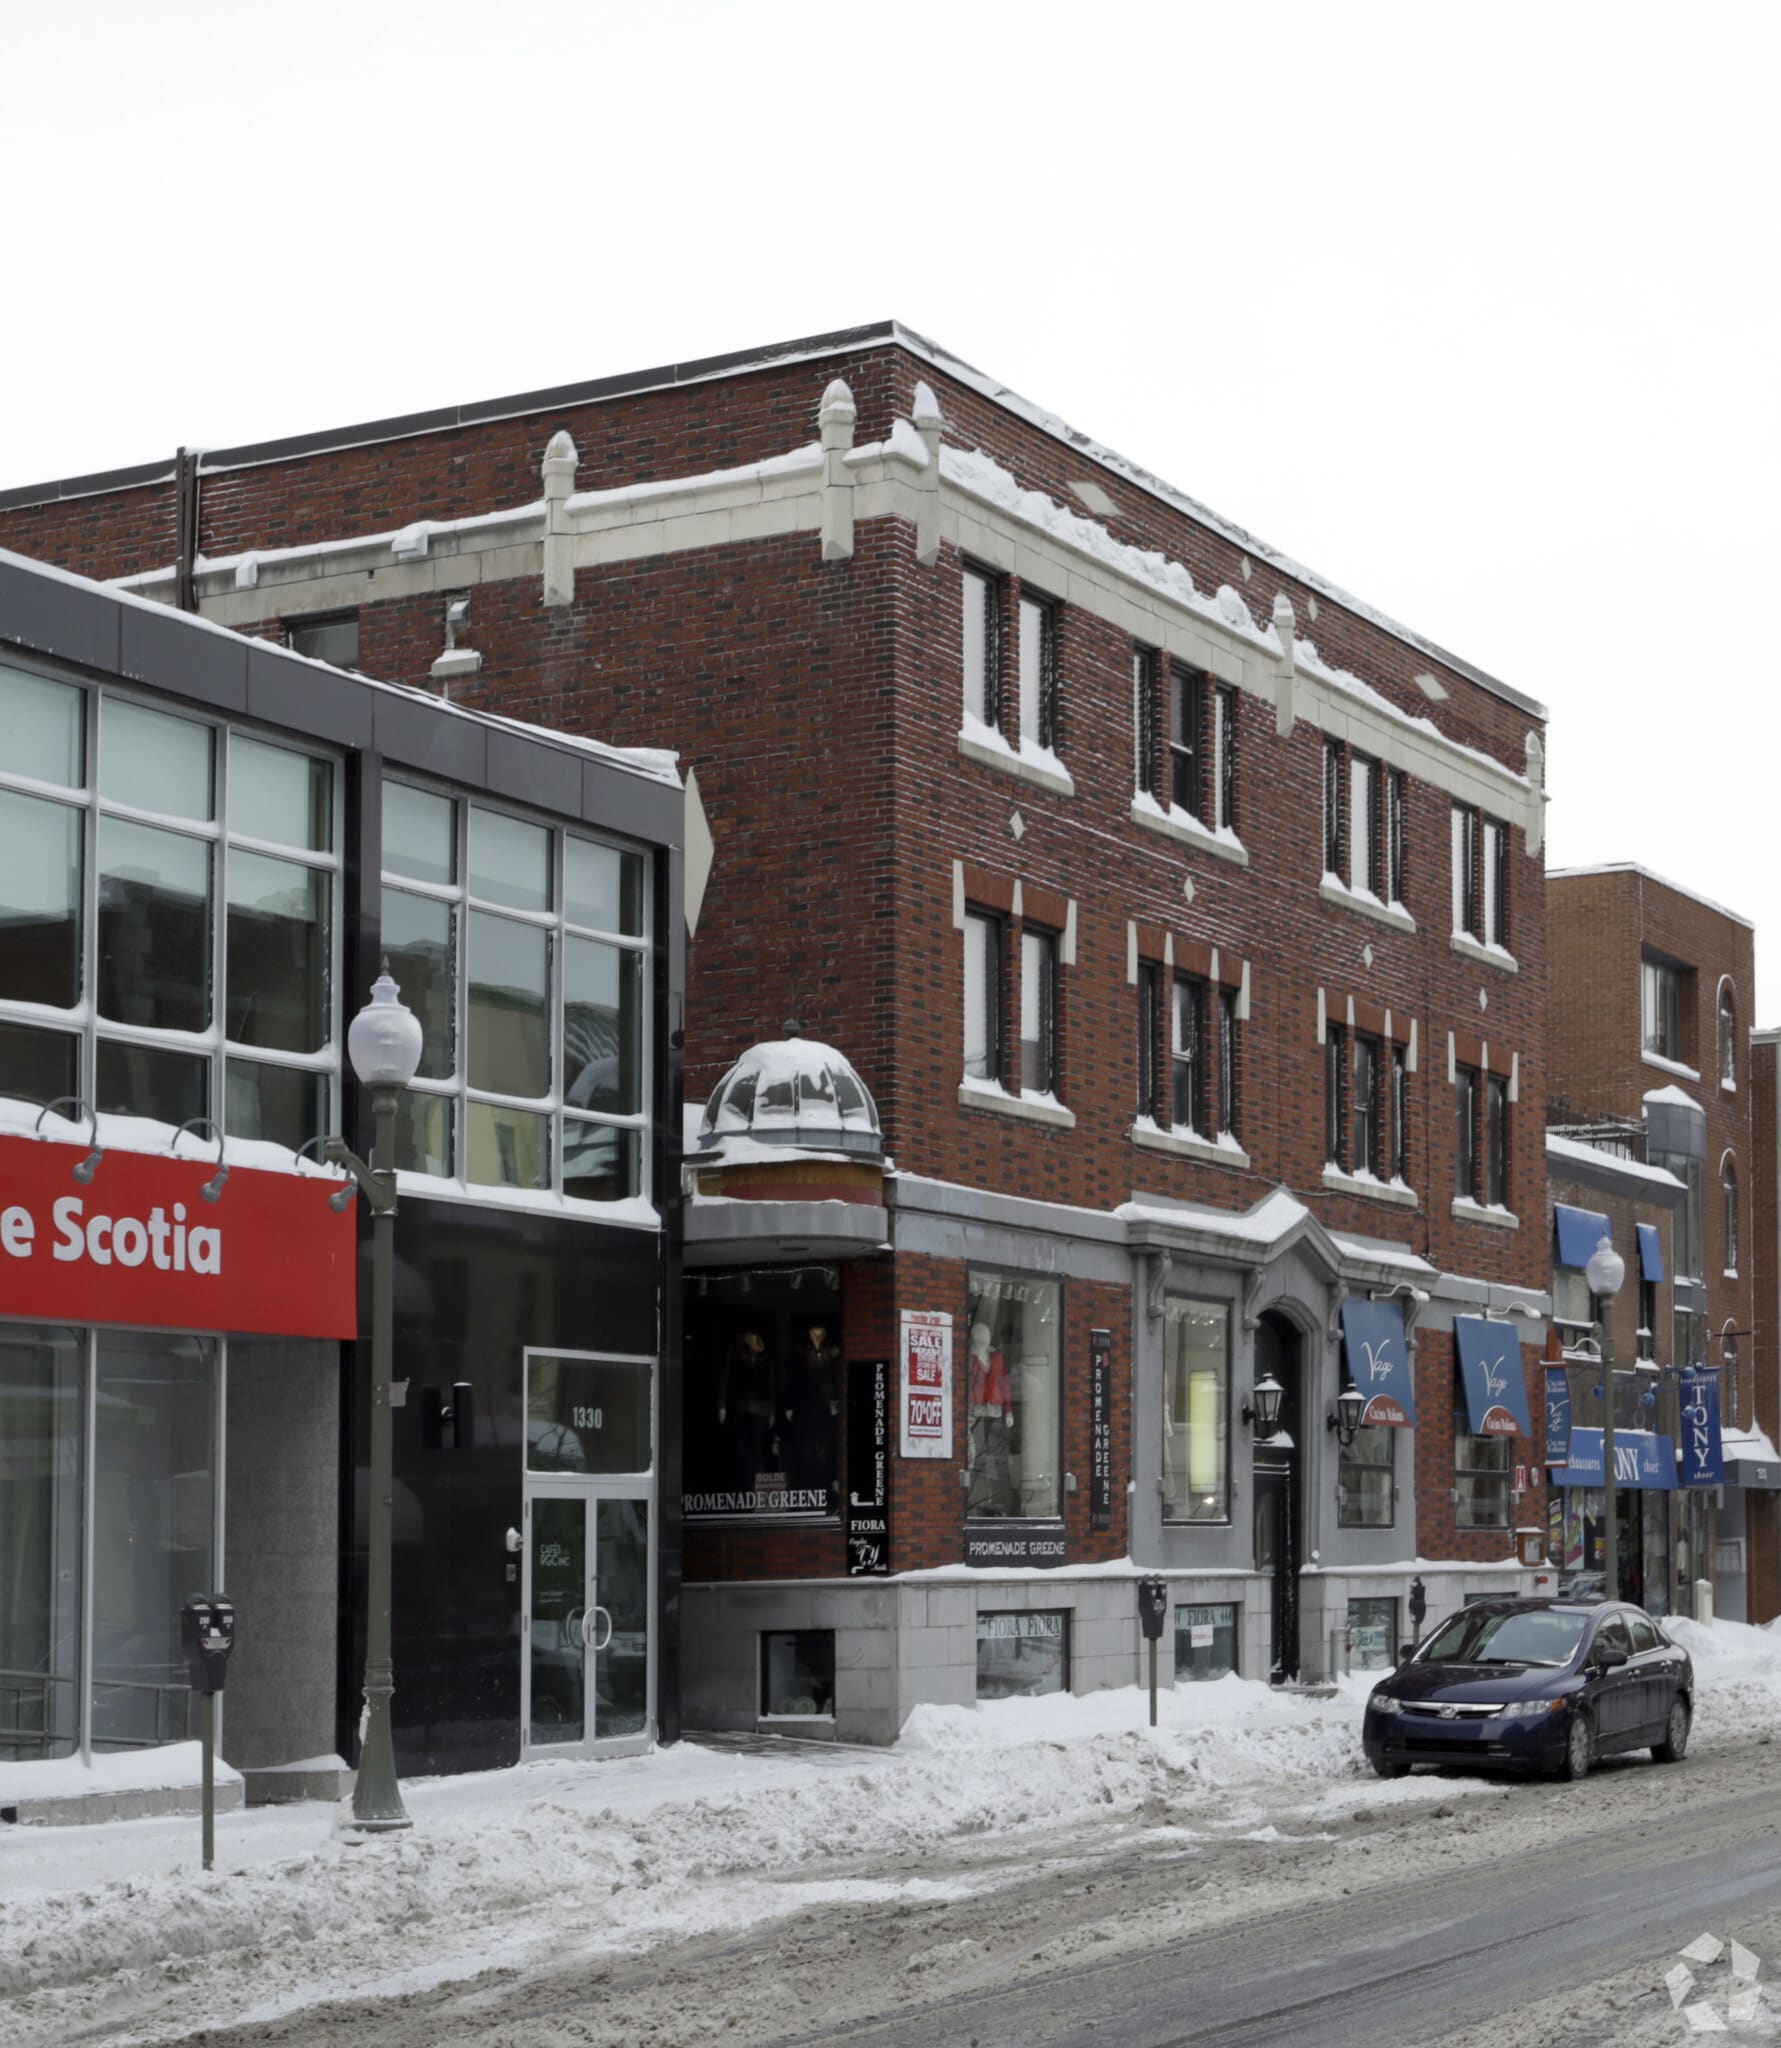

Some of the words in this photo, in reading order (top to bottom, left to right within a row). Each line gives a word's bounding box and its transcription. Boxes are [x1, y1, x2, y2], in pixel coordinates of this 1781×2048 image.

[52, 1195, 222, 1275] Scotia
[911, 1335, 943, 1350] SALE
[1360, 1338, 1394, 1382] Vago
[1478, 1355, 1508, 1397] Vago
[573, 1406, 603, 1429] 1330
[875, 1363, 885, 1446] PROMENADE
[1095, 1355, 1103, 1477] PROMENADE
[1692, 1385, 1711, 1468] TONY
[875, 1451, 885, 1506] GREENE
[1103, 1424, 1111, 1505] GREENE
[768, 1489, 828, 1509] GREENE
[851, 1519, 887, 1531] FIORA
[969, 1541, 1027, 1556] PROMENADE
[1029, 1541, 1065, 1556] GREENE
[987, 1617, 1020, 1637] FIORA
[1028, 1615, 1060, 1636] FIORA
[1188, 1608, 1216, 1626] FIORA
